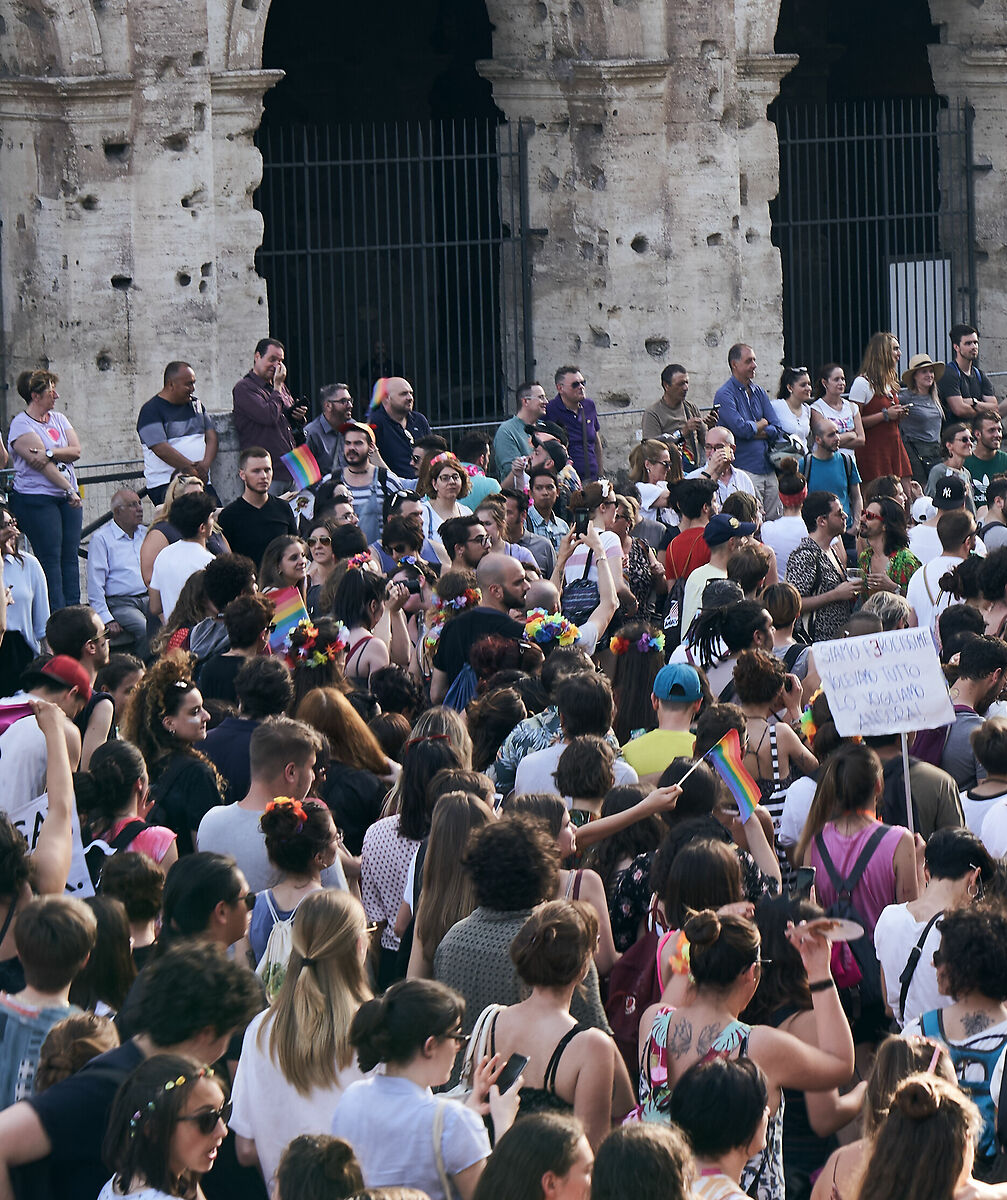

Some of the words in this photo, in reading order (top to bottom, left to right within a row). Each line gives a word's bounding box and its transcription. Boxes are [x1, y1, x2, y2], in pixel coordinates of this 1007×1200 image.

[820, 642, 860, 662] SIAMO
[881, 663, 921, 682] TUTTO
[833, 694, 856, 712] LO
[864, 683, 924, 706] VOGLIAMO
